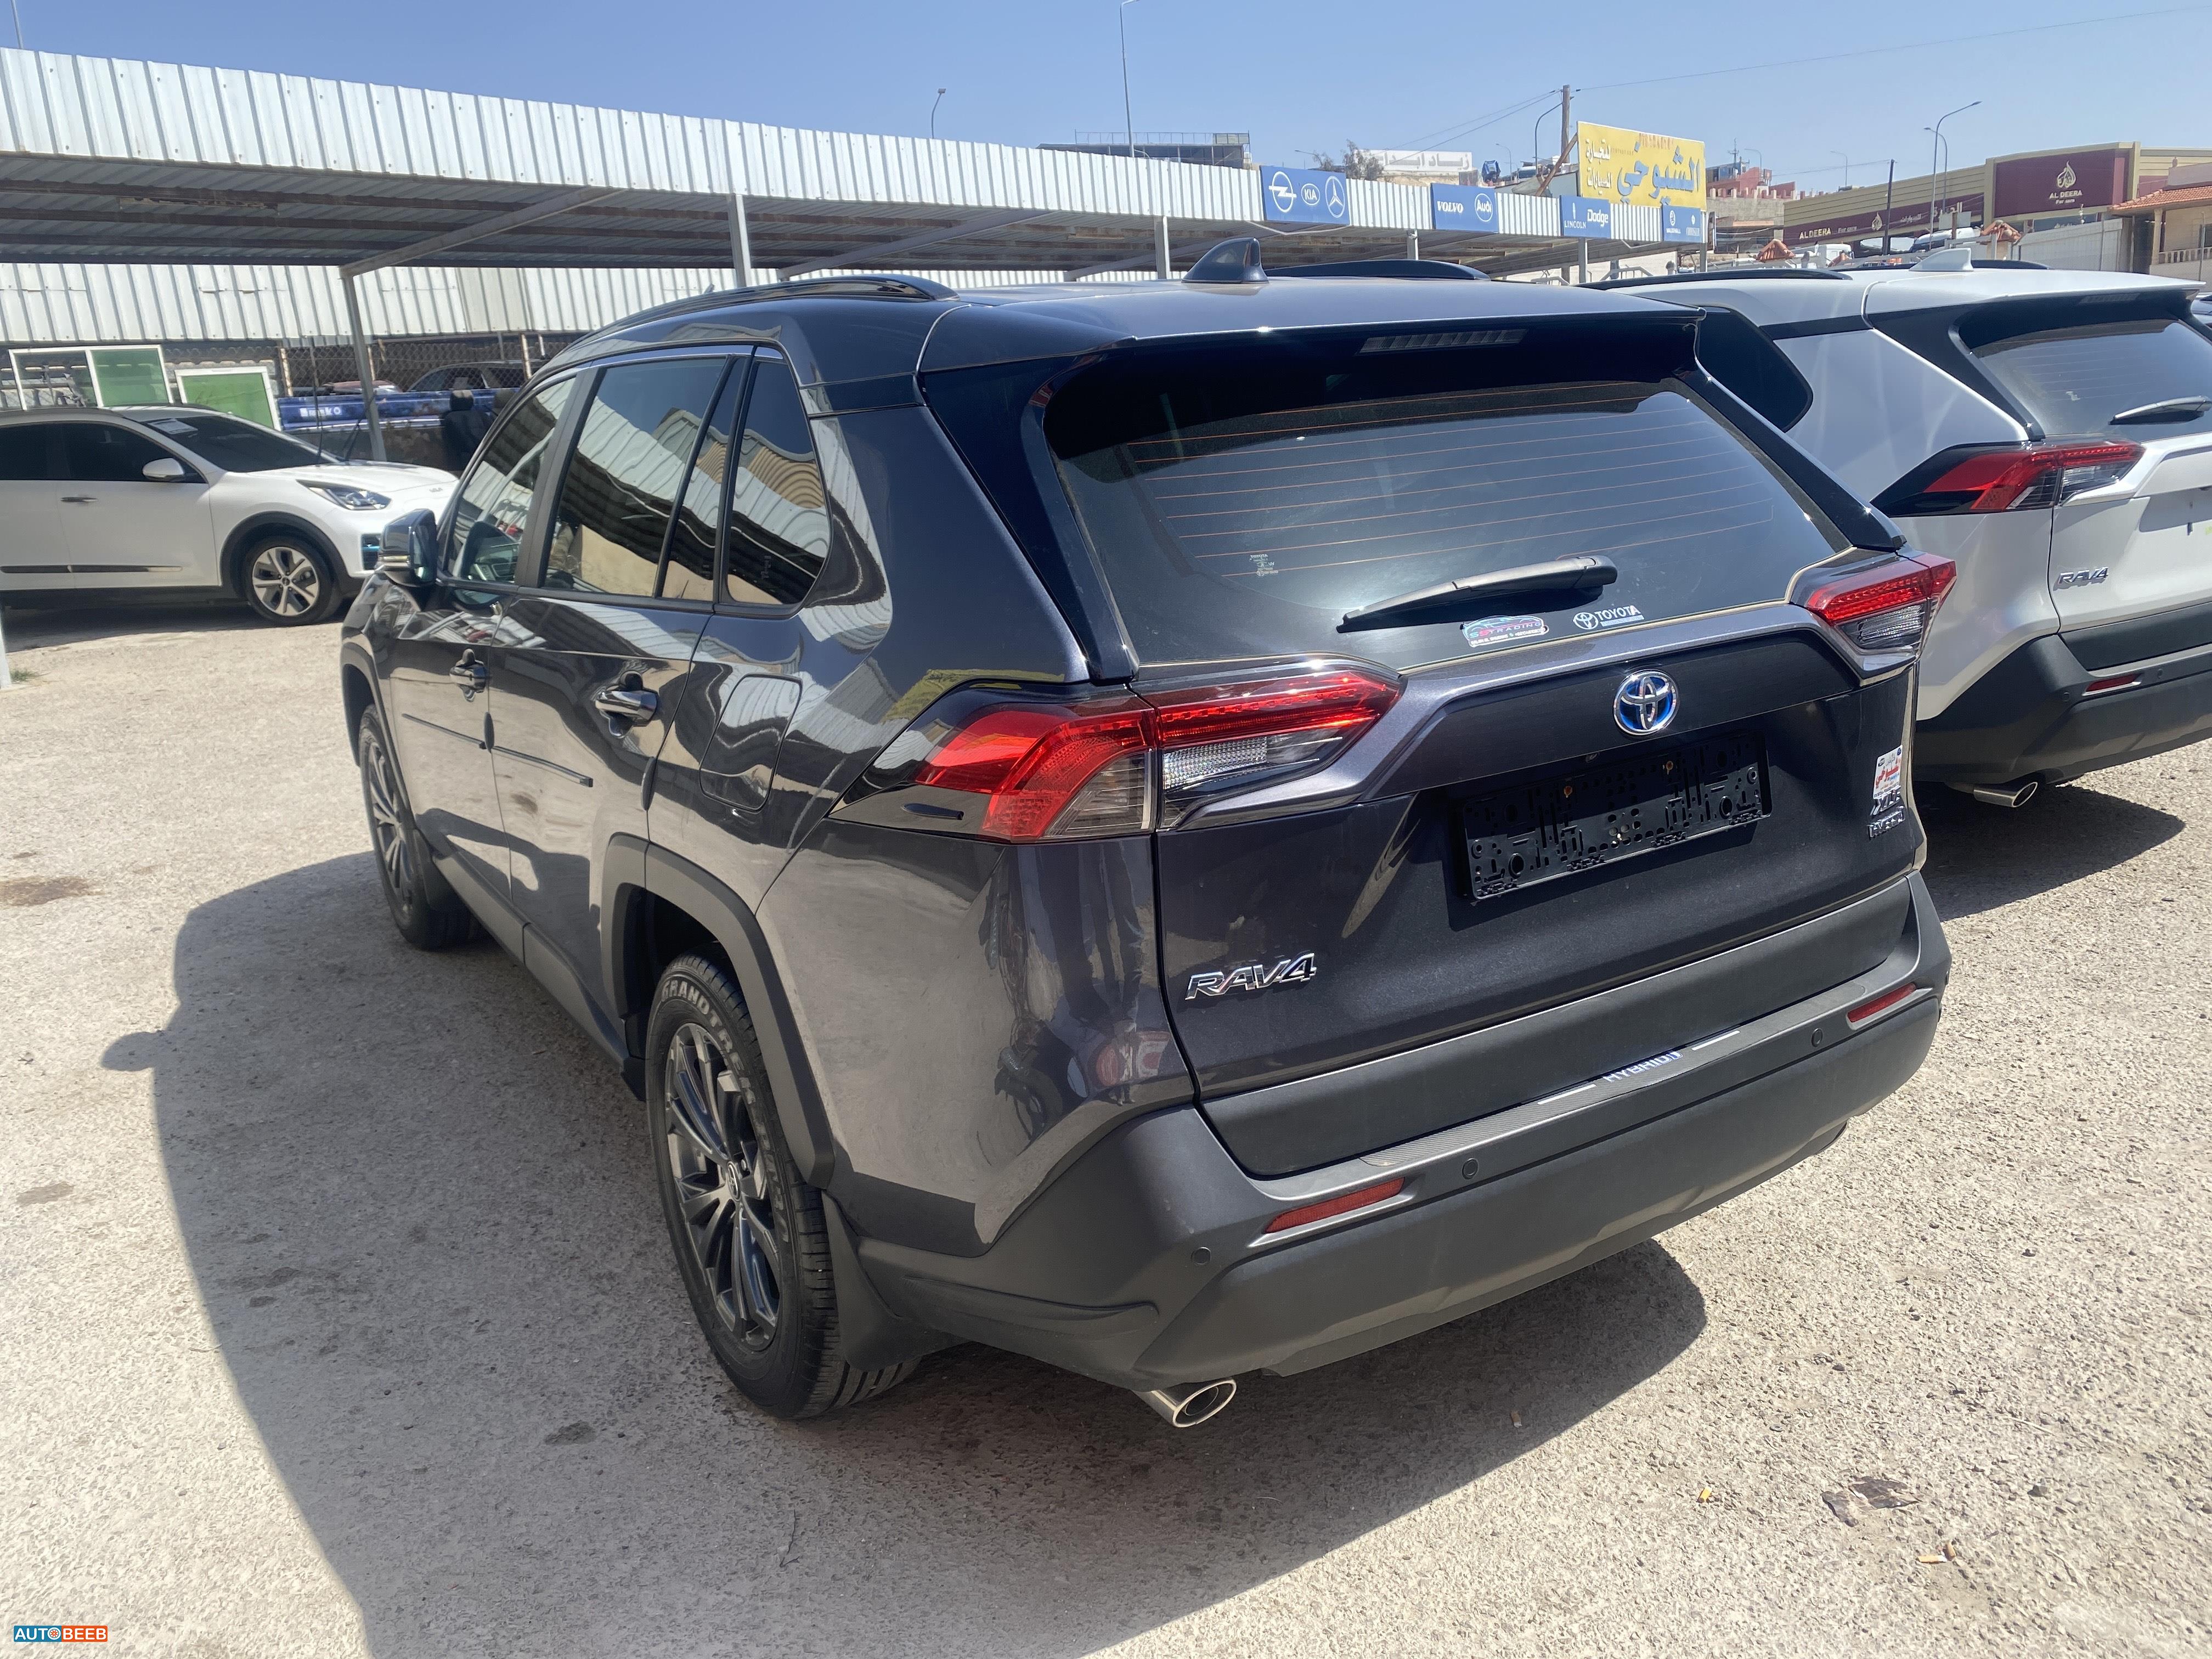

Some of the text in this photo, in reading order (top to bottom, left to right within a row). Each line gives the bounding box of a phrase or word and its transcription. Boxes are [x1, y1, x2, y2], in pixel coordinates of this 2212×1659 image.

[1305, 188, 1318, 200] KIA
[2060, 190, 2083, 198] DEERA
[1437, 199, 1492, 213] VOLVO Audi
[1564, 220, 1587, 229] LINCOLN
[1587, 209, 1609, 228] Dodge
[2058, 566, 2109, 585] RAV4
[1595, 605, 1641, 621] TOYOTA
[1184, 952, 1317, 1001] RAV4
